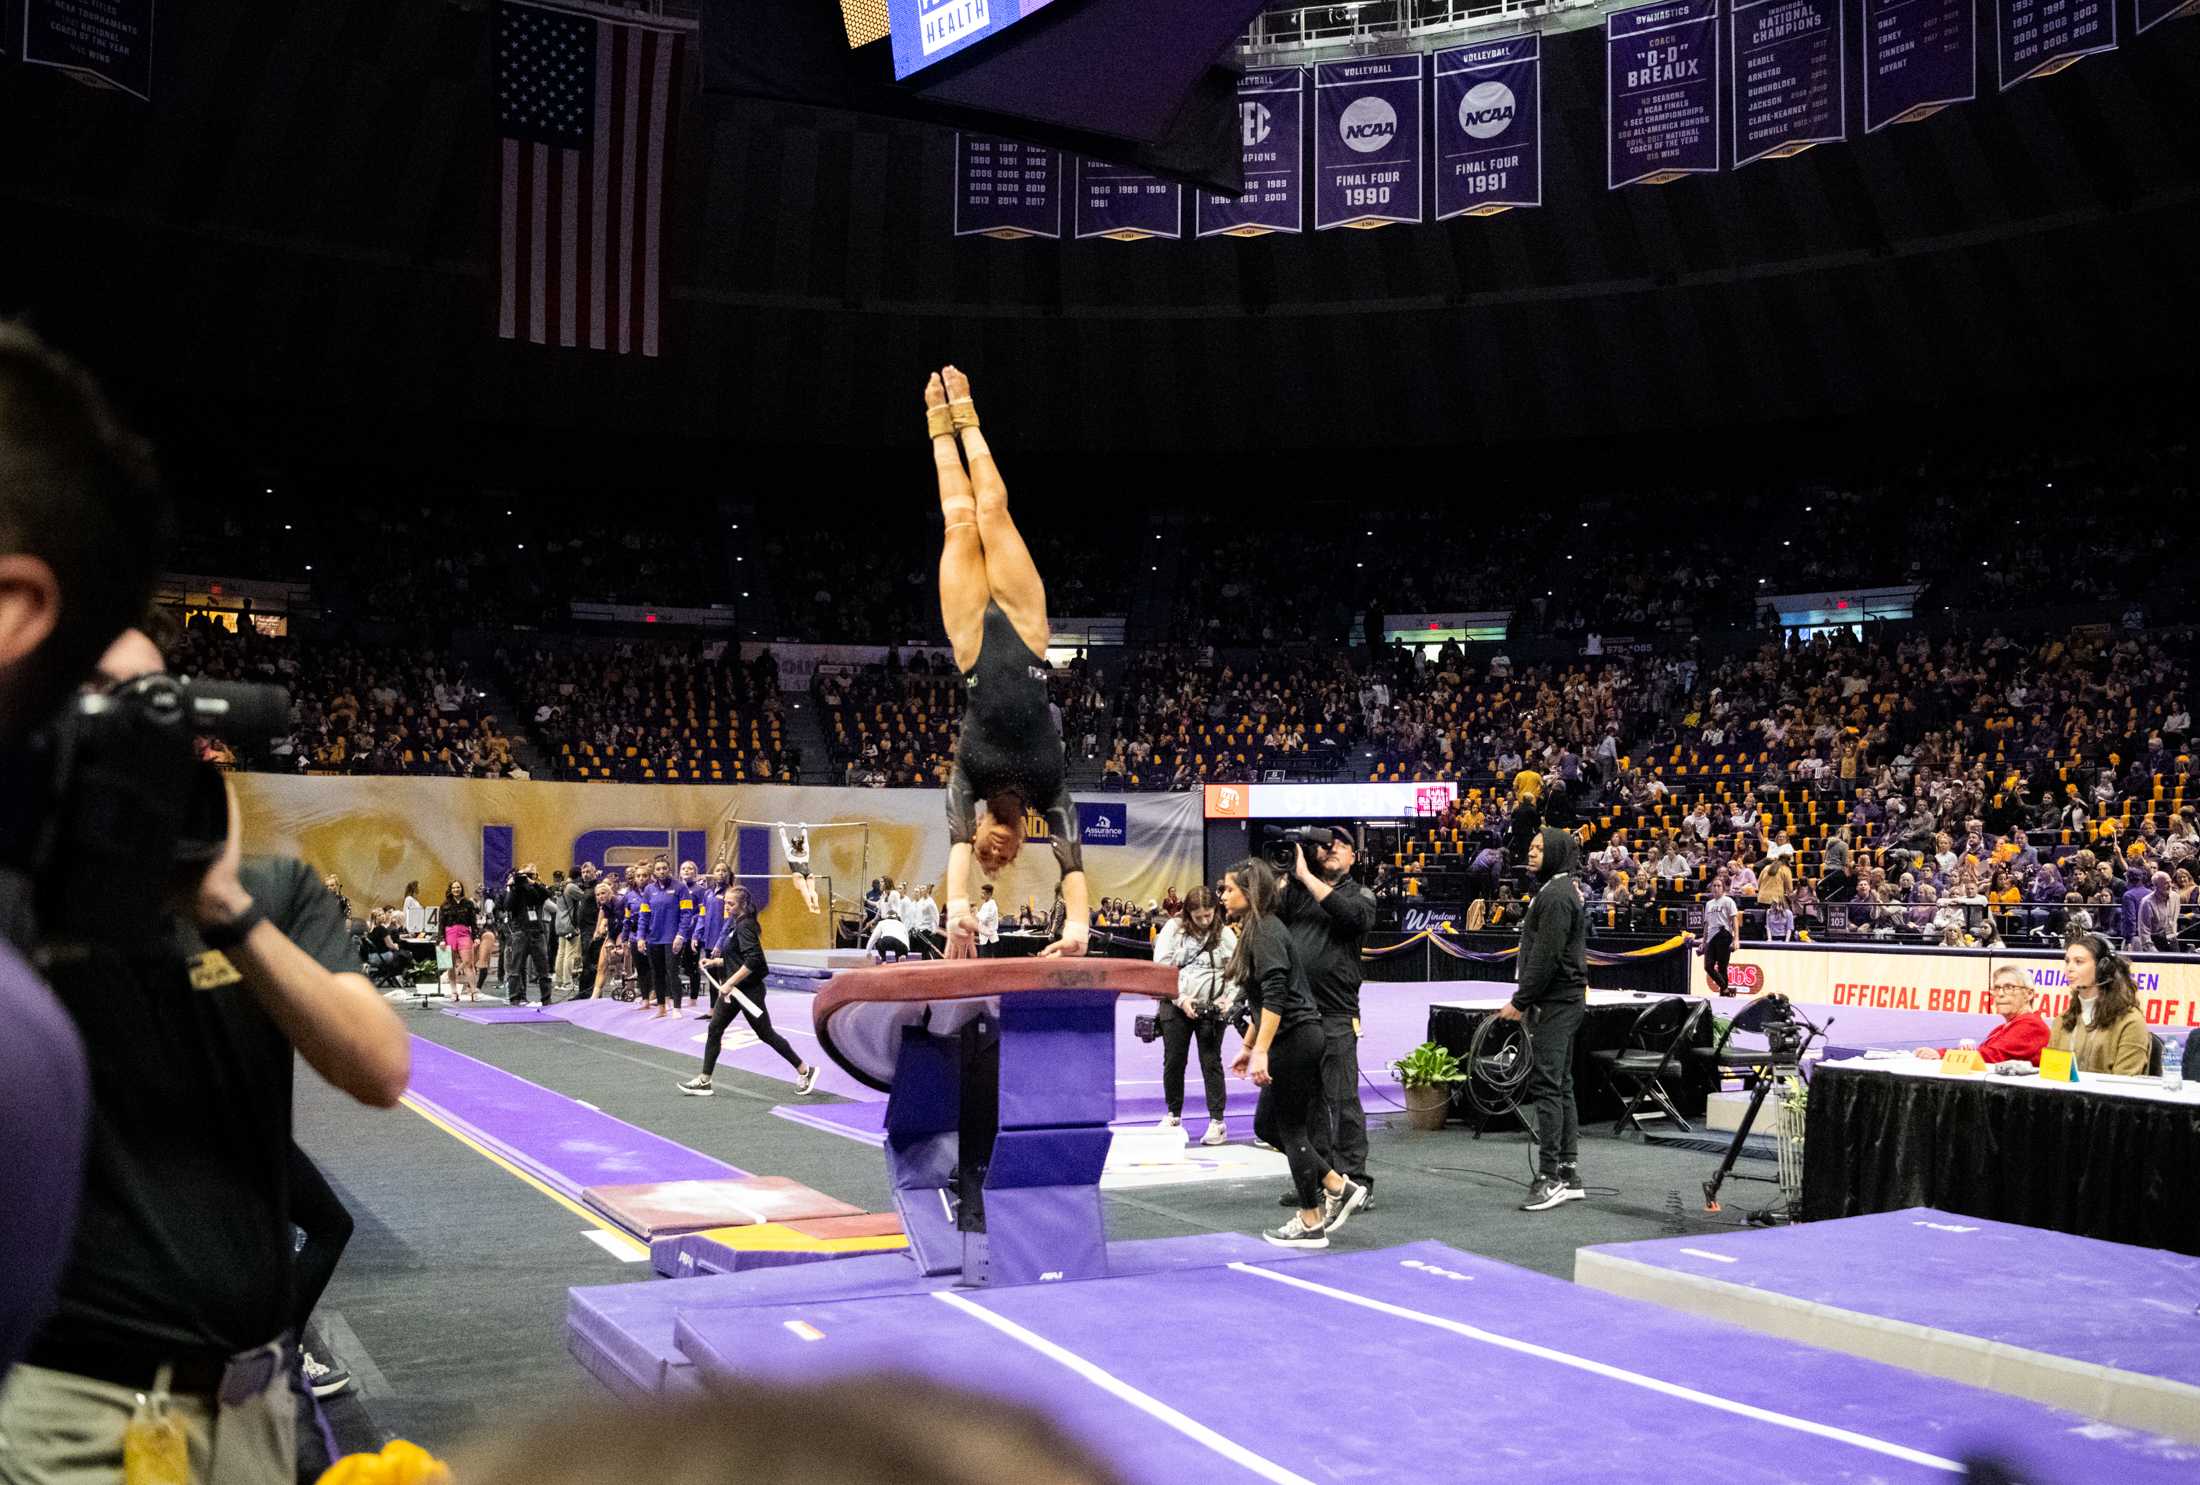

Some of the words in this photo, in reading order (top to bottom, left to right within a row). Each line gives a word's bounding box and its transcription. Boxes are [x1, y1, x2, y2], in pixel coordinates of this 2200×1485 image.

[926, 0, 984, 44] HEALTH
[1636, 5, 1690, 25] GYMNASTICS
[1759, 5, 1815, 30] NATIONAL
[1752, 14, 1822, 44] CHAMPIONS
[1649, 34, 1677, 48] COACH
[1463, 47, 1510, 63] VOLLEYBALL
[1343, 64, 1392, 77] VOLLEYBALL
[1627, 58, 1699, 88] BREAUX
[1239, 101, 1272, 146] EC
[1465, 105, 1513, 127] NCAA
[1346, 121, 1395, 140] NCAA
[1455, 160, 1487, 176] FINAL
[1489, 155, 1519, 171] FOUR
[1336, 174, 1367, 187] FINAL
[1370, 171, 1400, 185] FOUR
[1467, 172, 1507, 195] 1991
[1345, 186, 1390, 206] 1990
[1084, 826, 1122, 836] Assurance
[427, 907, 438, 927] 4
[1689, 916, 1702, 925] 102
[1831, 917, 1844, 927] 103
[1832, 983, 1921, 1010] OFFICIAL
[2145, 998, 2179, 1025] OF
